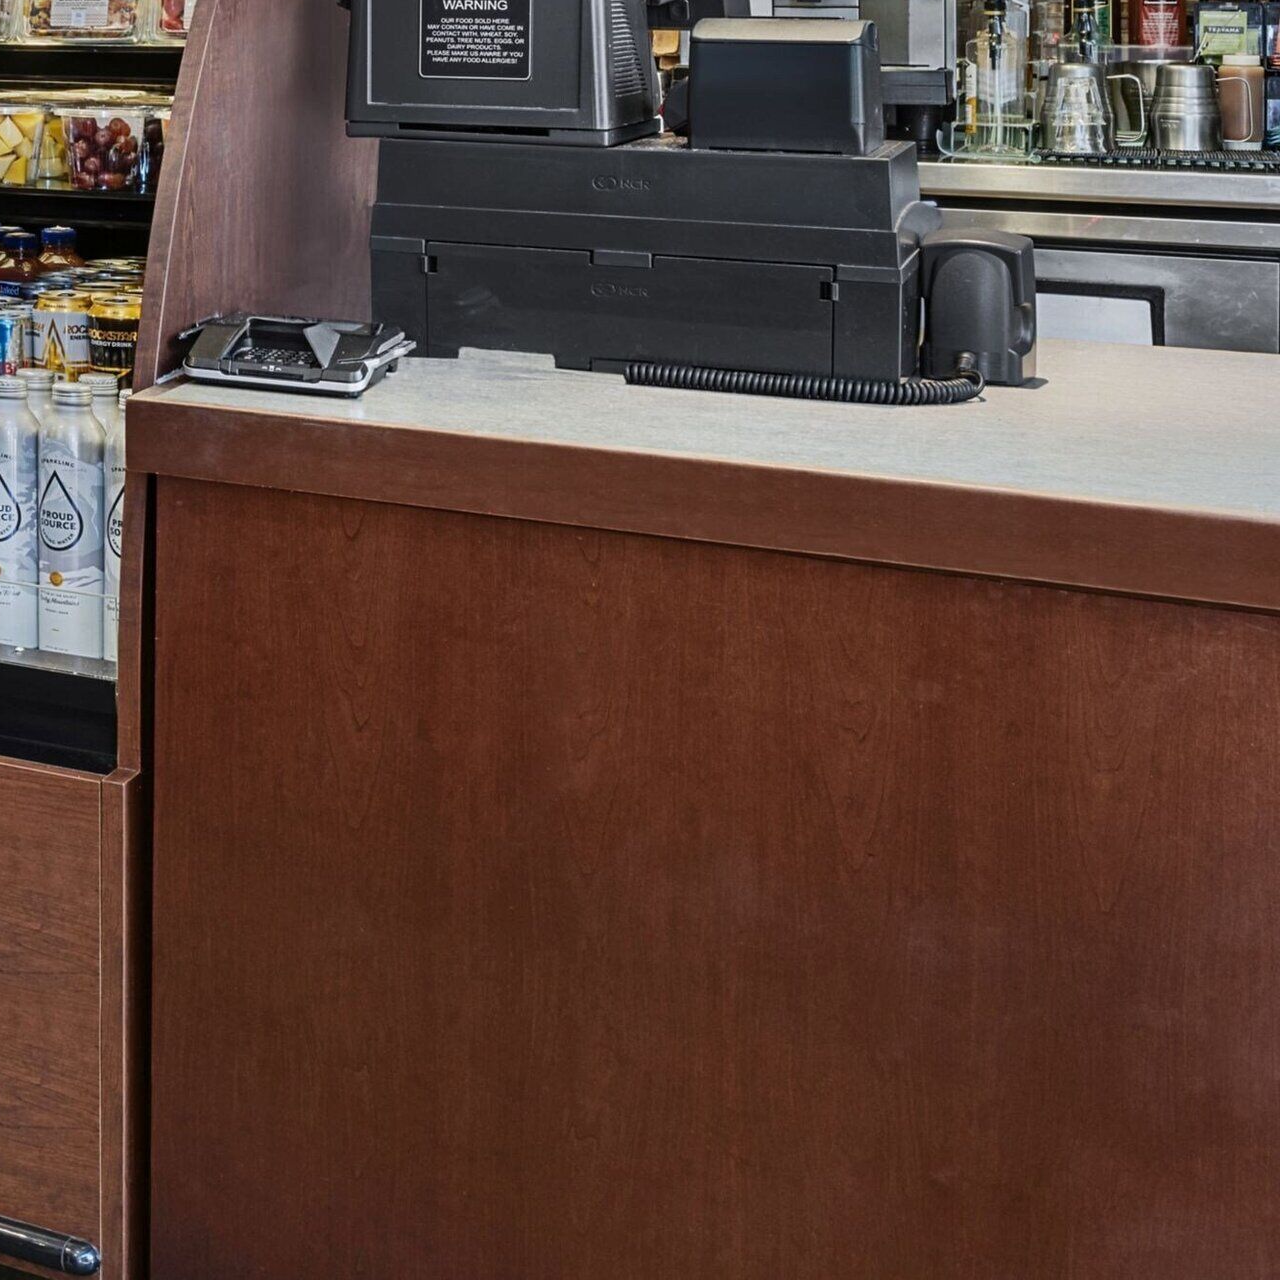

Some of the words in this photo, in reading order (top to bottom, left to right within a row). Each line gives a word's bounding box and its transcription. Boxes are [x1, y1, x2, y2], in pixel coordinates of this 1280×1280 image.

[443, 0, 508, 10] WARNING
[42, 510, 74, 521] PROUD
[41, 518, 75, 530] SOURCE
